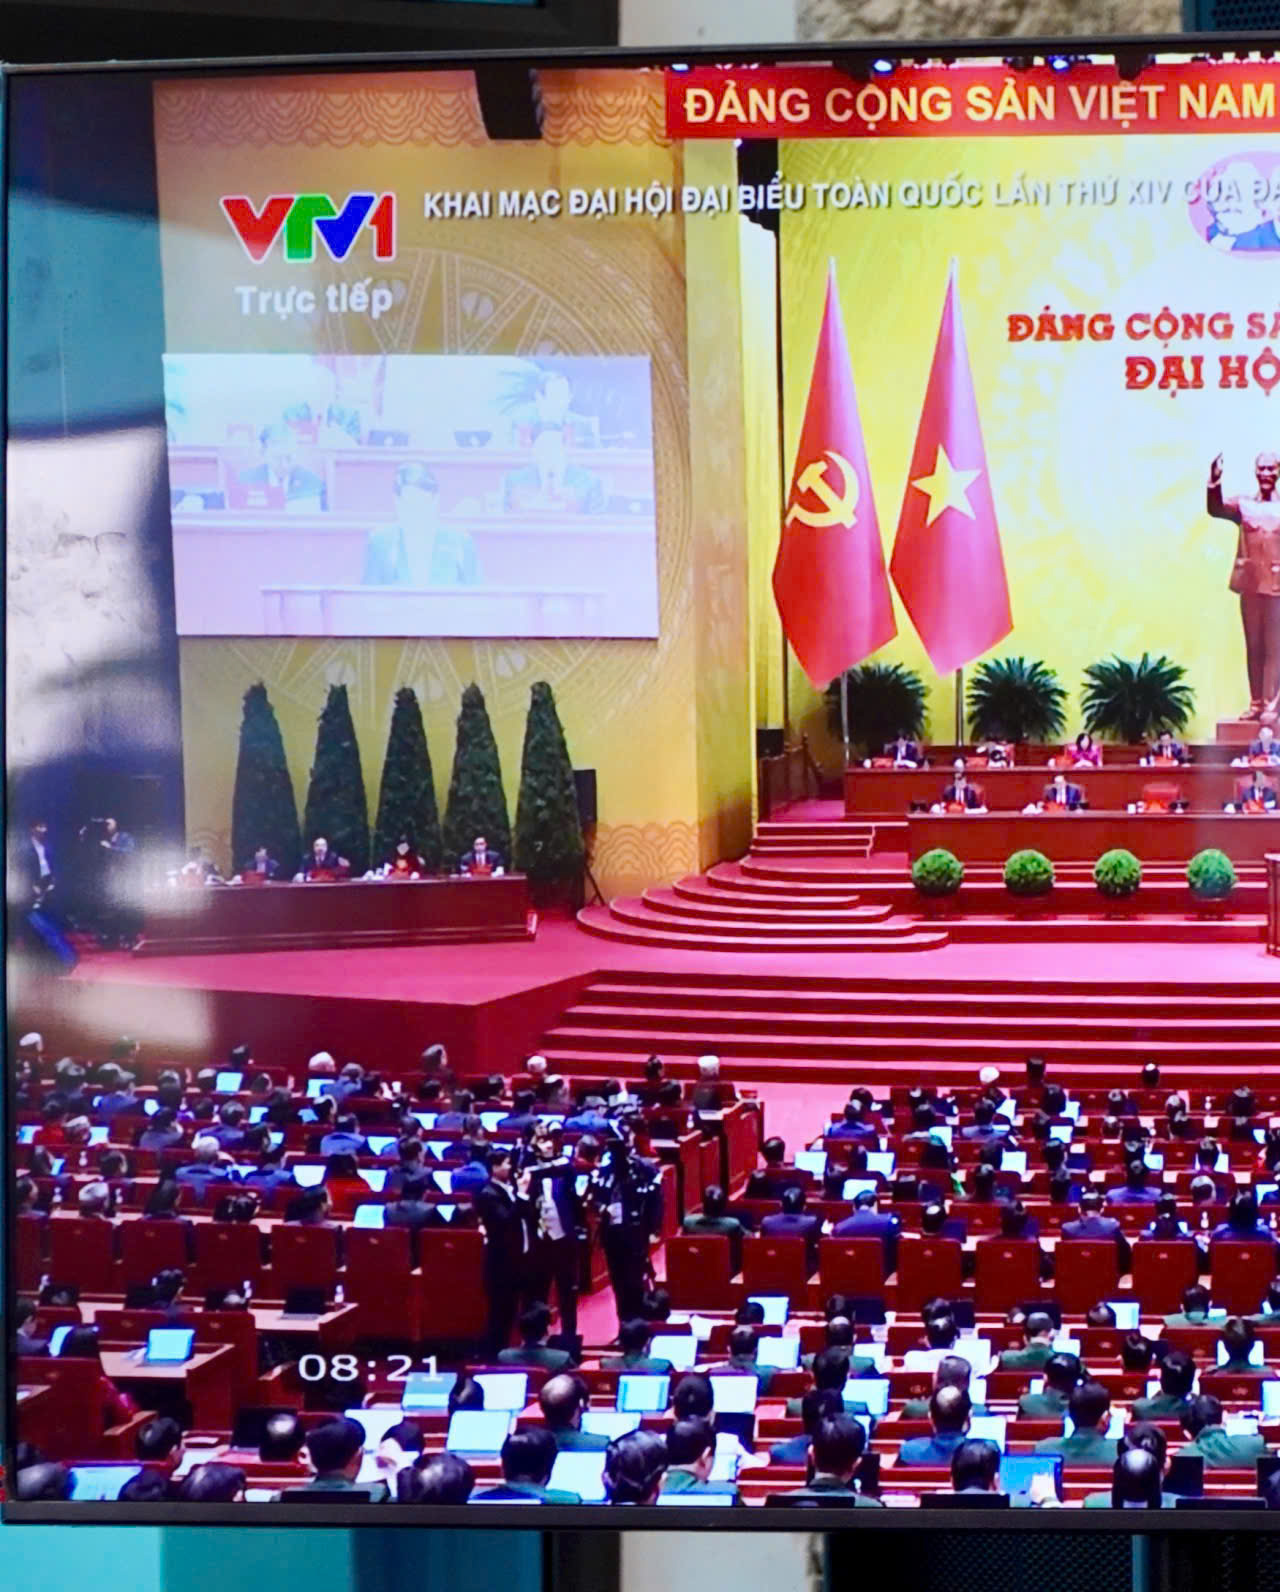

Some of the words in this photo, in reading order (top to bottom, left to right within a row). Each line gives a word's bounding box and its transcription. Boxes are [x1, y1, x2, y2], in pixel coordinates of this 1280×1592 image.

[683, 79, 811, 123] ĐẢNG
[825, 83, 952, 130] CỘNG
[965, 77, 1055, 121] SẢN
[1068, 80, 1165, 129] VIỆT
[1179, 83, 1276, 120] NAM
[424, 191, 492, 219] KHAI
[498, 190, 562, 223] MẠC
[569, 187, 617, 221] ĐẠI
[625, 179, 673, 219] HỘI
[681, 184, 729, 220] ĐẠI
[737, 171, 806, 211] BIỂU
[813, 175, 891, 209] TOÀN
[898, 171, 983, 208] QUỐC
[1129, 180, 1174, 205] XIV
[219, 191, 396, 264] VTV1
[235, 284, 316, 320] Trực
[325, 277, 394, 320] tiếp
[1007, 304, 1115, 342] ĐẢNG
[1125, 306, 1235, 349] CỘNG
[1125, 355, 1205, 398] ĐẠI
[298, 1354, 444, 1383] 08:21
